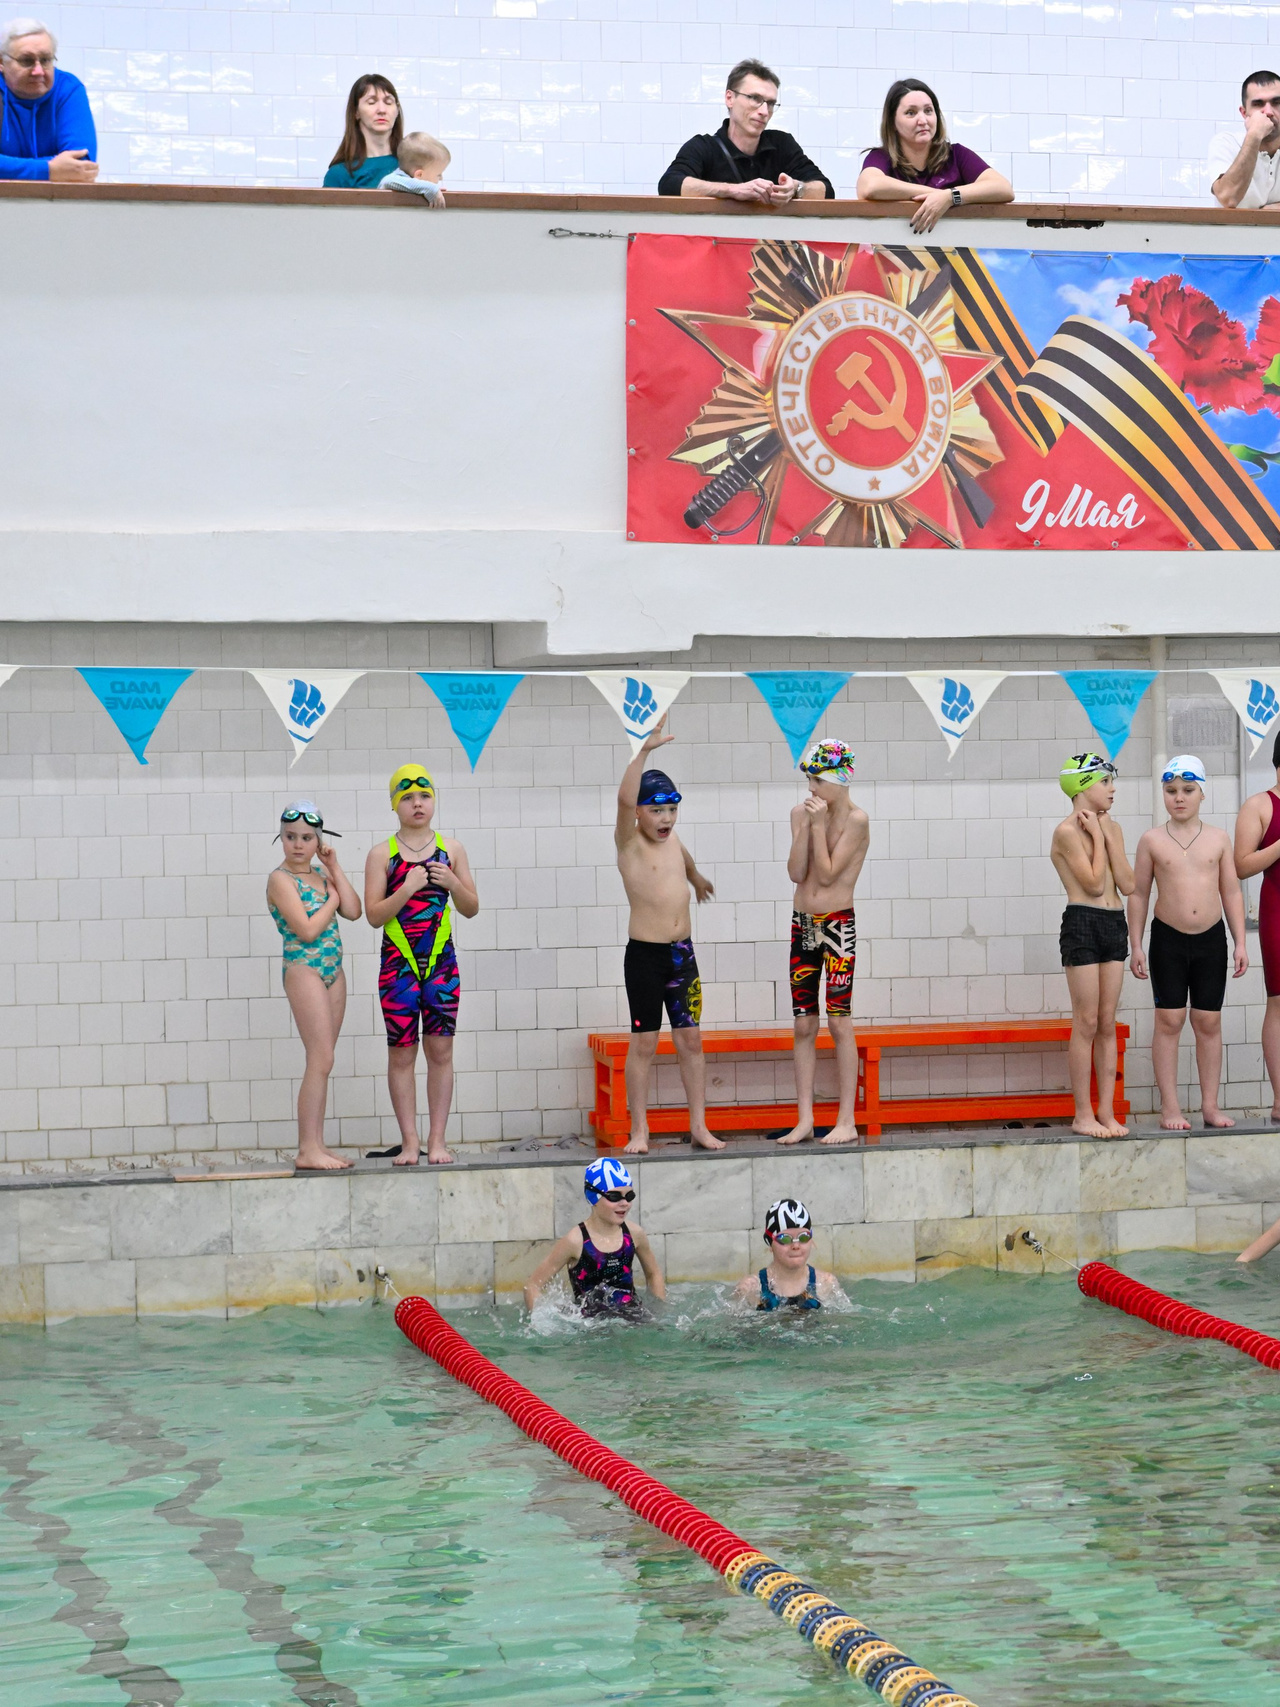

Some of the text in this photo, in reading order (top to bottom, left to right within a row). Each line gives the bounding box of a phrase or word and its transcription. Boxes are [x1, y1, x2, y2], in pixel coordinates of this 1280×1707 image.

[782, 303, 935, 476] ОТЕЧЕСТВЕННАЯ
[1015, 478, 1146, 533] 9 Мая
